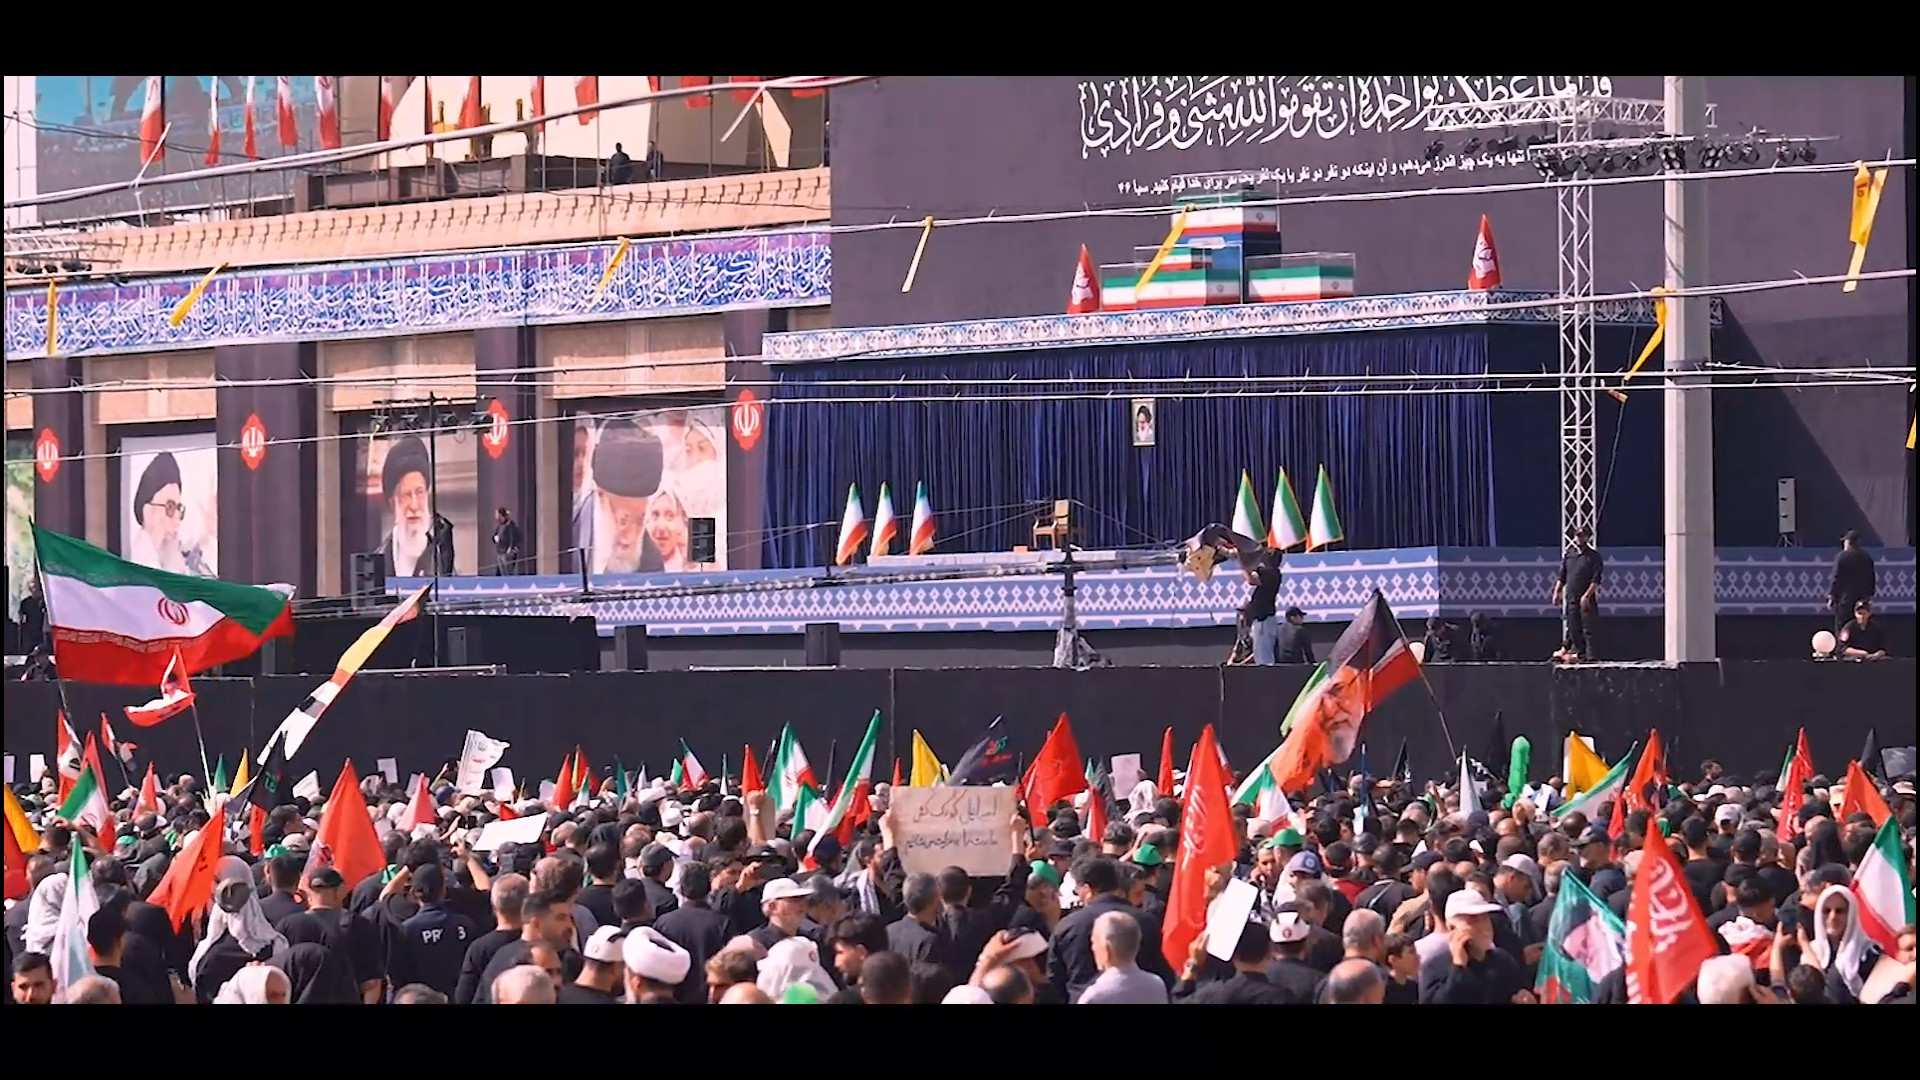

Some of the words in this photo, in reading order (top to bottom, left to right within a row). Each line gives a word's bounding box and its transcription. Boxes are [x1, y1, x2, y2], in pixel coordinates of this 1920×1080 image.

[1476, 152, 1493, 168] یک
[1494, 154, 1505, 167] به
[1297, 166, 1311, 183] نفر
[1312, 168, 1323, 183] دو
[1324, 163, 1338, 182] نفر
[1340, 166, 1351, 181] دو
[1390, 162, 1397, 176] و
